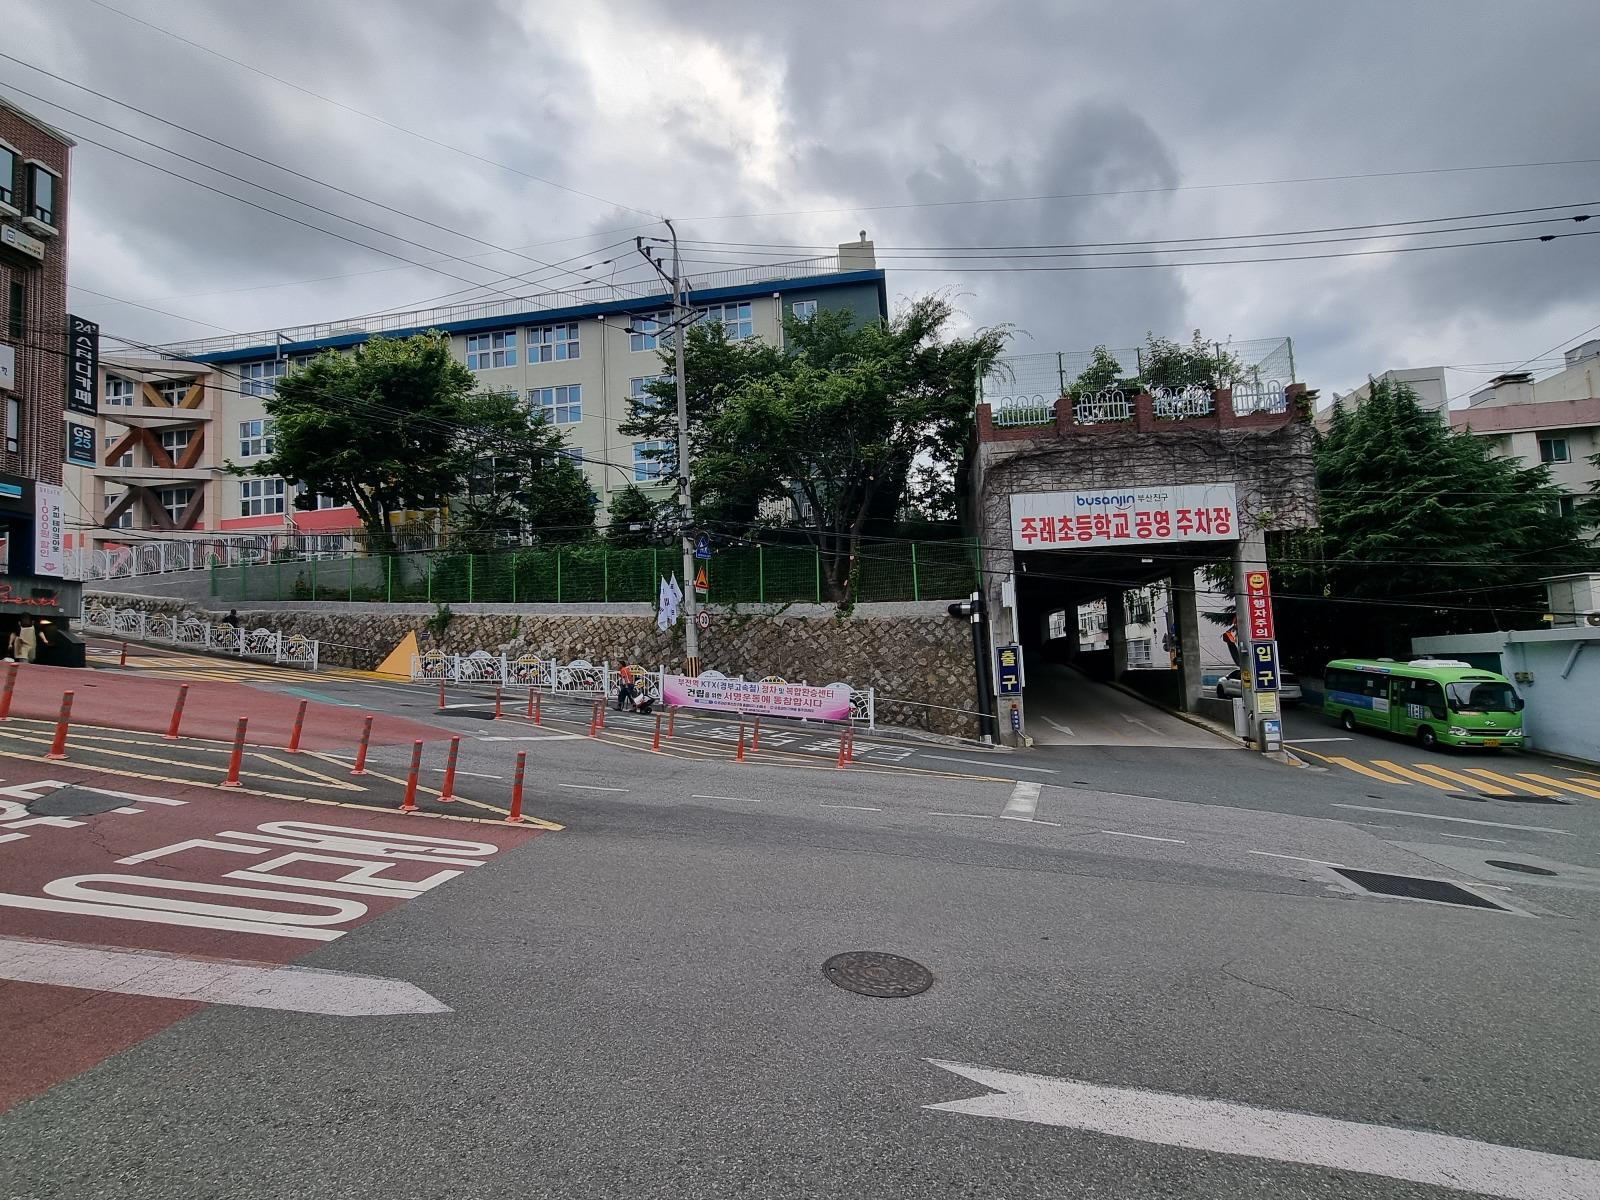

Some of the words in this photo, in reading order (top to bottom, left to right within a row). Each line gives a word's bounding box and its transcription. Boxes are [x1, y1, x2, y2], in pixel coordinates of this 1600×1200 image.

[75, 336, 93, 405] 스터디카페
[73, 426, 92, 439] GS
[73, 436, 92, 449] 25
[40, 498, 49, 538] 1000원
[52, 505, 60, 518] 커피
[1076, 495, 1135, 507] busanjin
[1137, 492, 1169, 503] 부산진구
[1020, 512, 1131, 545] 주레초등학교
[1135, 510, 1171, 539] 공영
[1176, 507, 1232, 536] 주차장
[1252, 589, 1268, 637] 보행자주의
[1000, 650, 1018, 691] 출구
[1256, 645, 1274, 687] 입구
[678, 678, 699, 687] 부전역
[761, 685, 777, 695] 정차
[786, 686, 834, 699] 복합환승센터
[723, 692, 771, 704] 서명운동에
[773, 695, 823, 708] 동참합시다
[0, 820, 499, 942] 어린이
